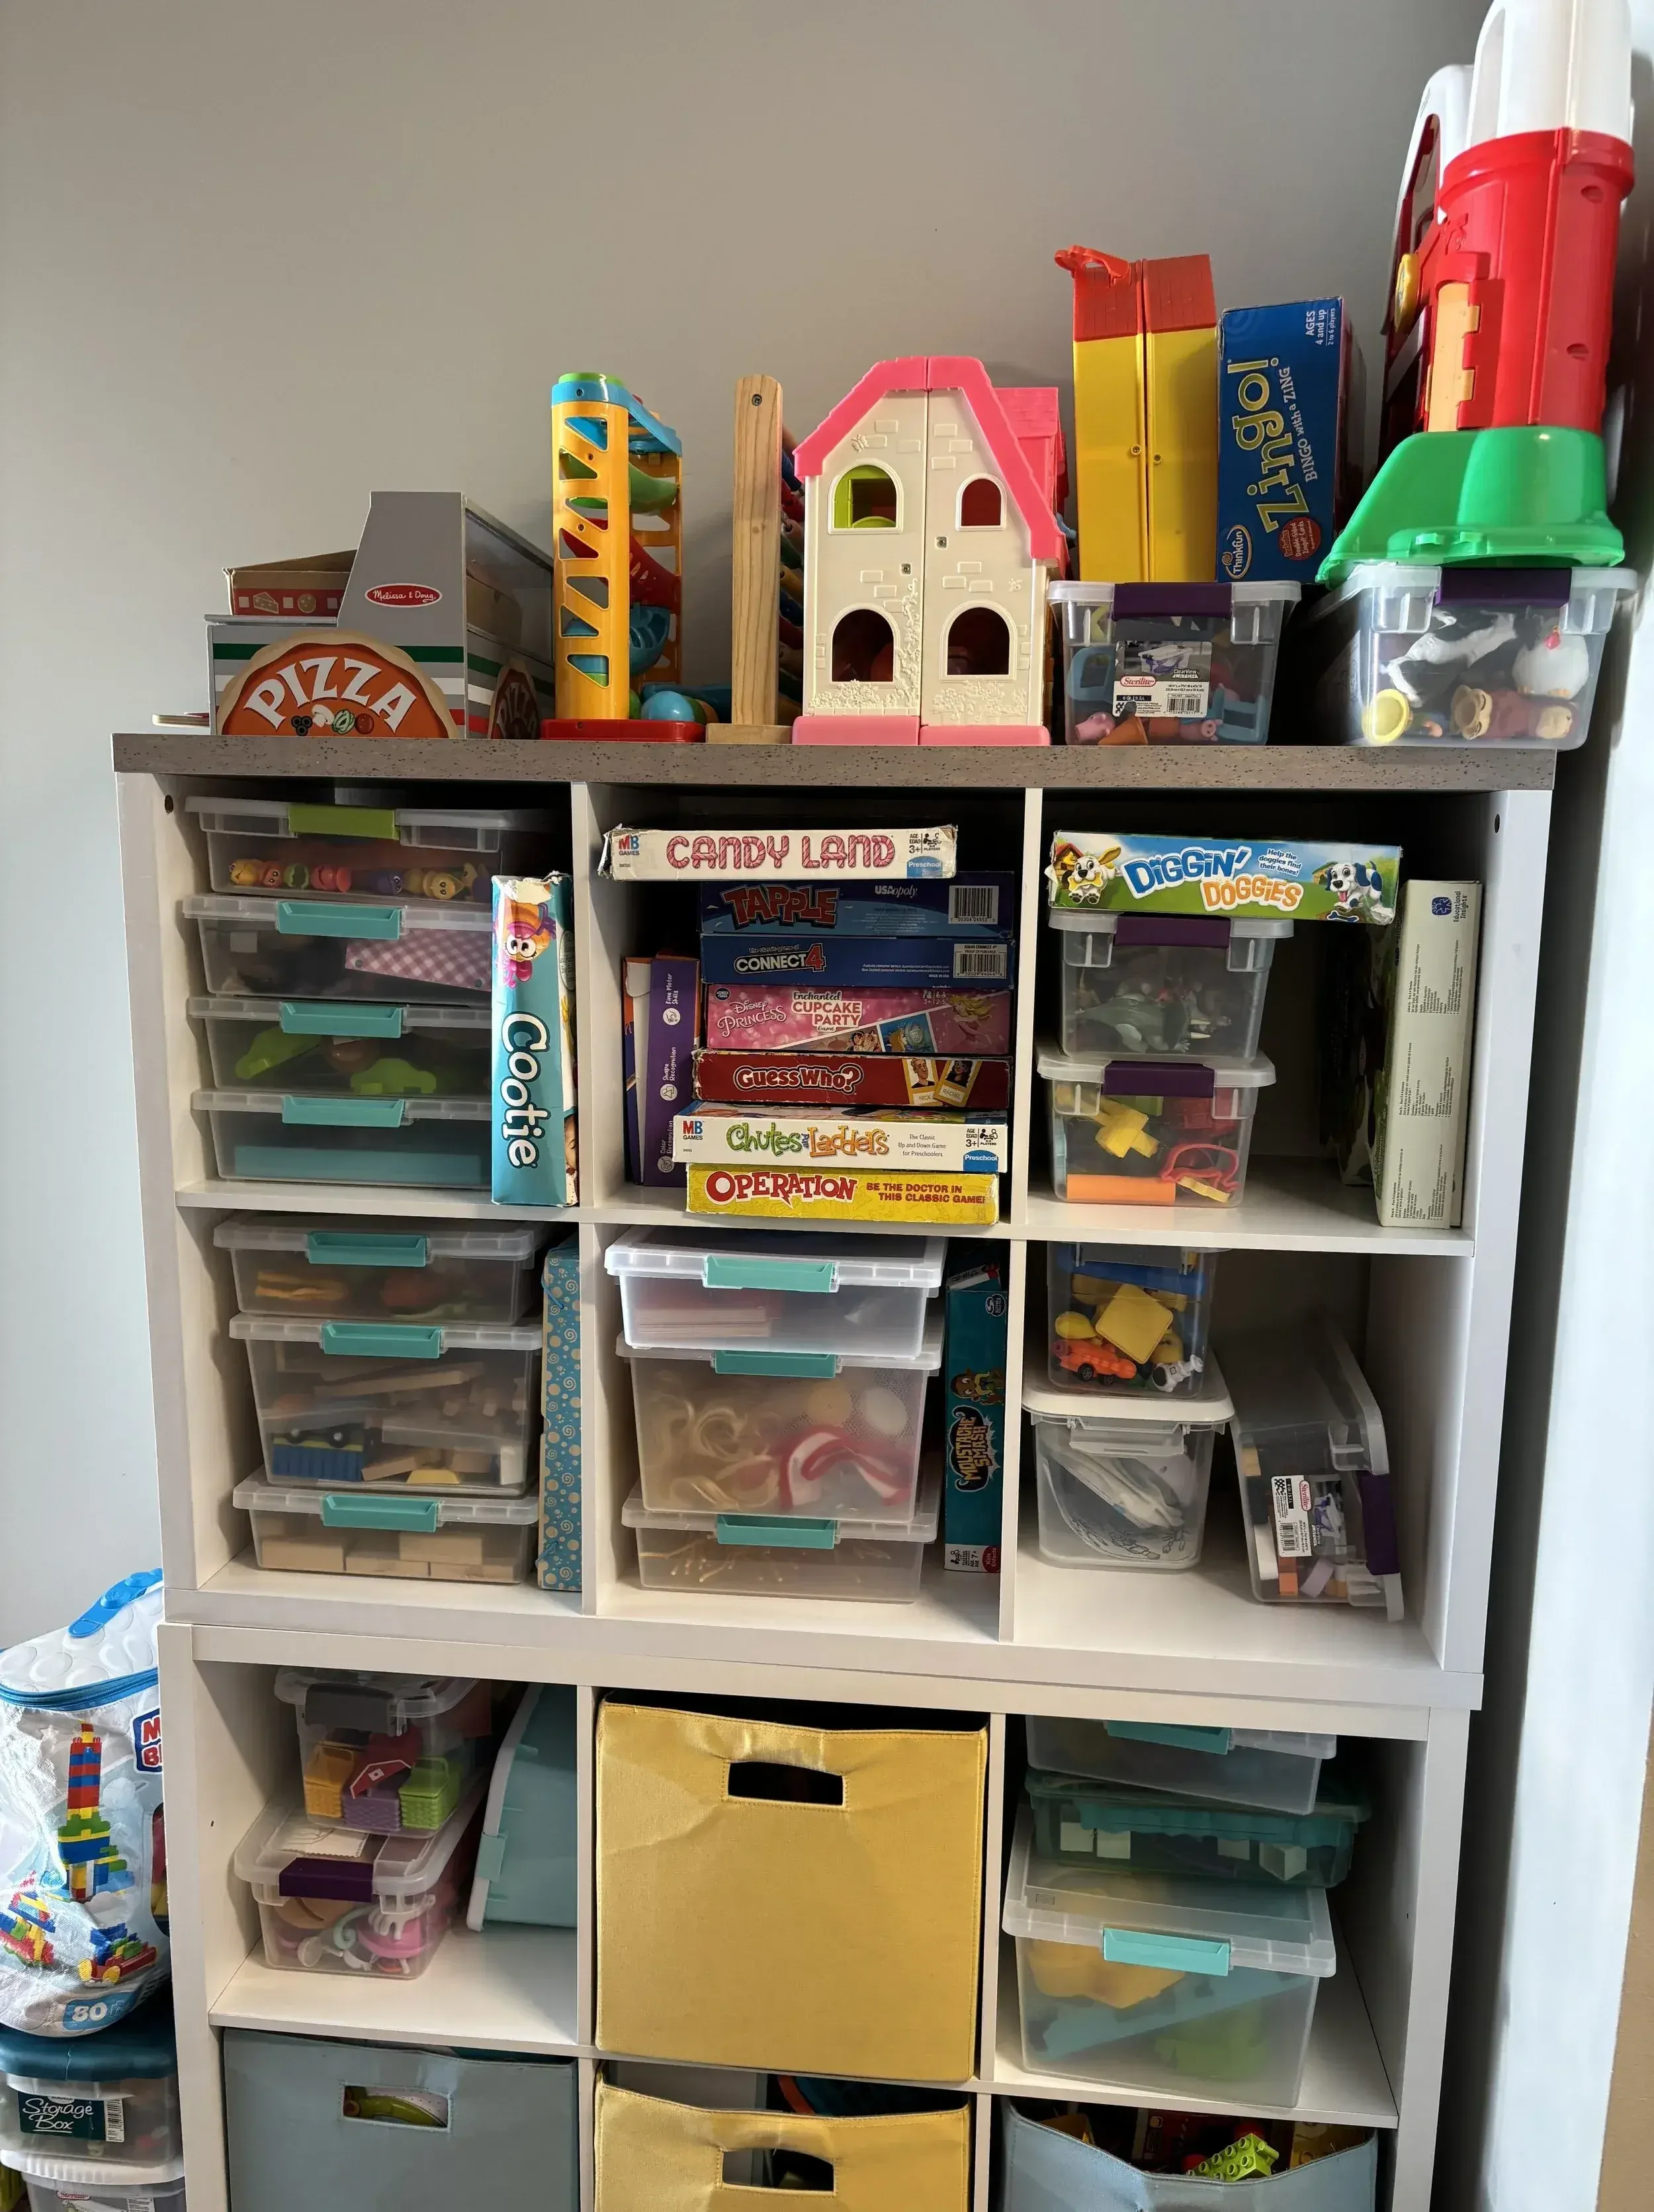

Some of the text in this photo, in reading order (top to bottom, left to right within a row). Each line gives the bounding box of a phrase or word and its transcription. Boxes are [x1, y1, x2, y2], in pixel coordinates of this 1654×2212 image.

[1305, 311, 1315, 335] AGES
[1319, 309, 1327, 320] up
[1315, 322, 1325, 337] and
[1279, 367, 1296, 404] ZING
[1291, 410, 1304, 436] with
[1227, 357, 1309, 533] Zingo!
[1297, 438, 1318, 482] BINGO
[372, 590, 406, 601] Melissa
[415, 590, 434, 603] Doug
[1123, 677, 1154, 686] Sterilite
[243, 656, 417, 733] PIZZA
[619, 835, 640, 850] MB
[666, 835, 896, 869] CANDY LAND
[909, 845, 920, 854] 3+
[1268, 849, 1284, 858] Help
[1259, 856, 1301, 869] doggies find
[1277, 865, 1299, 875] bones!
[721, 885, 840, 925] TAPPLE
[1453, 891, 1461, 922] Educational
[1460, 895, 1469, 919] Insights
[736, 944, 824, 971] CONNECT 4
[793, 992, 841, 1000] Enchanted
[793, 1002, 861, 1014] CUPCAKE
[717, 1005, 787, 1037] PRINCESS
[814, 1014, 861, 1025] PARTY
[799, 1065, 861, 1092] Who?
[501, 1013, 550, 1169] Cootie
[683, 1120, 703, 1134] MB
[726, 1122, 889, 1157] Chutes and Ladders
[966, 1139, 977, 1147] 3+
[706, 1171, 857, 1206] OPERATION
[866, 1182, 880, 1191] BE
[883, 1183, 903, 1192] THE
[906, 1184, 948, 1193] DOCTOR
[879, 1192, 985, 1204] THIS CLASSIC GAME!
[955, 1417, 982, 1480] MOUSTACHE
[971, 1426, 992, 1467] SMASH
[1301, 1483, 1309, 1510] Sterilite
[22, 2098, 94, 2119] Storage
[28, 2113, 74, 2129] Box
